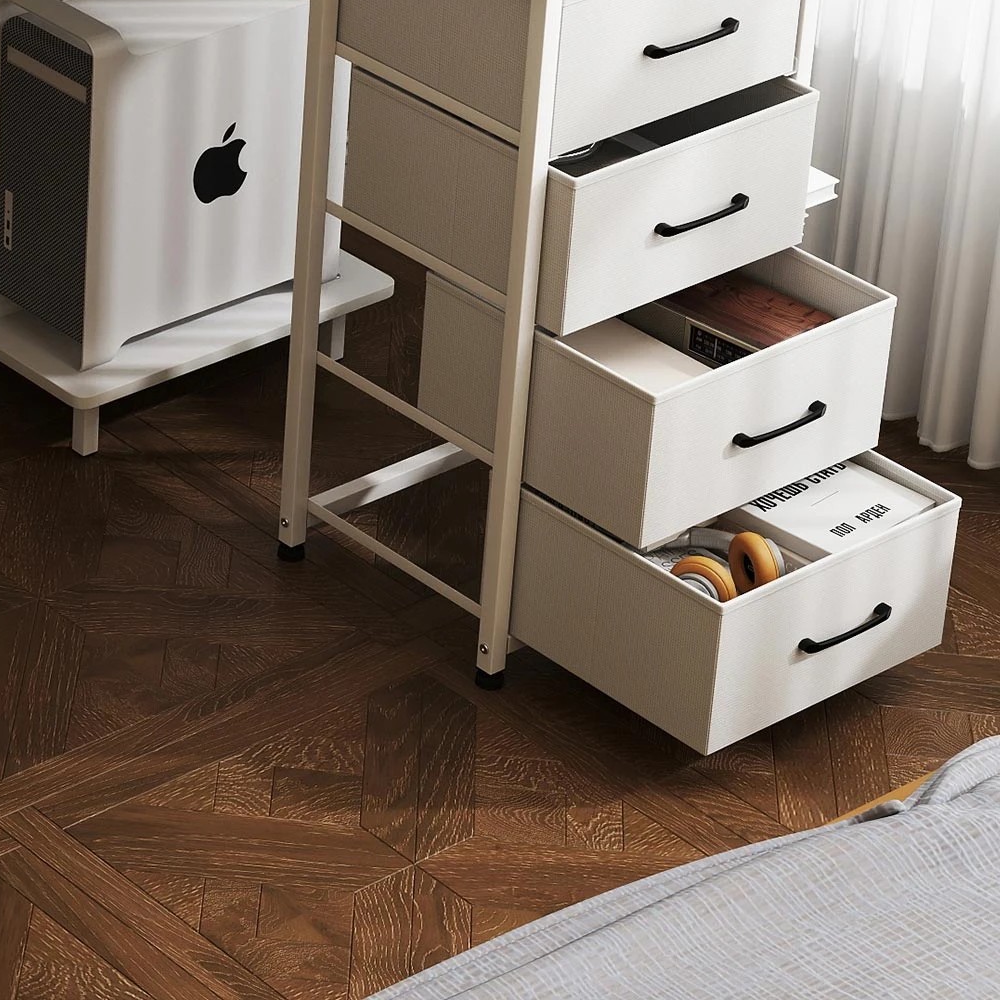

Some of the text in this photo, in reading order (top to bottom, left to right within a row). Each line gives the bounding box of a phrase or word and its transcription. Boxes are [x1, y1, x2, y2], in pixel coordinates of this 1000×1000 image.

[749, 482, 809, 512] ХОЧЕШЬ
[829, 503, 891, 537] ПОЛ АРДЕН
